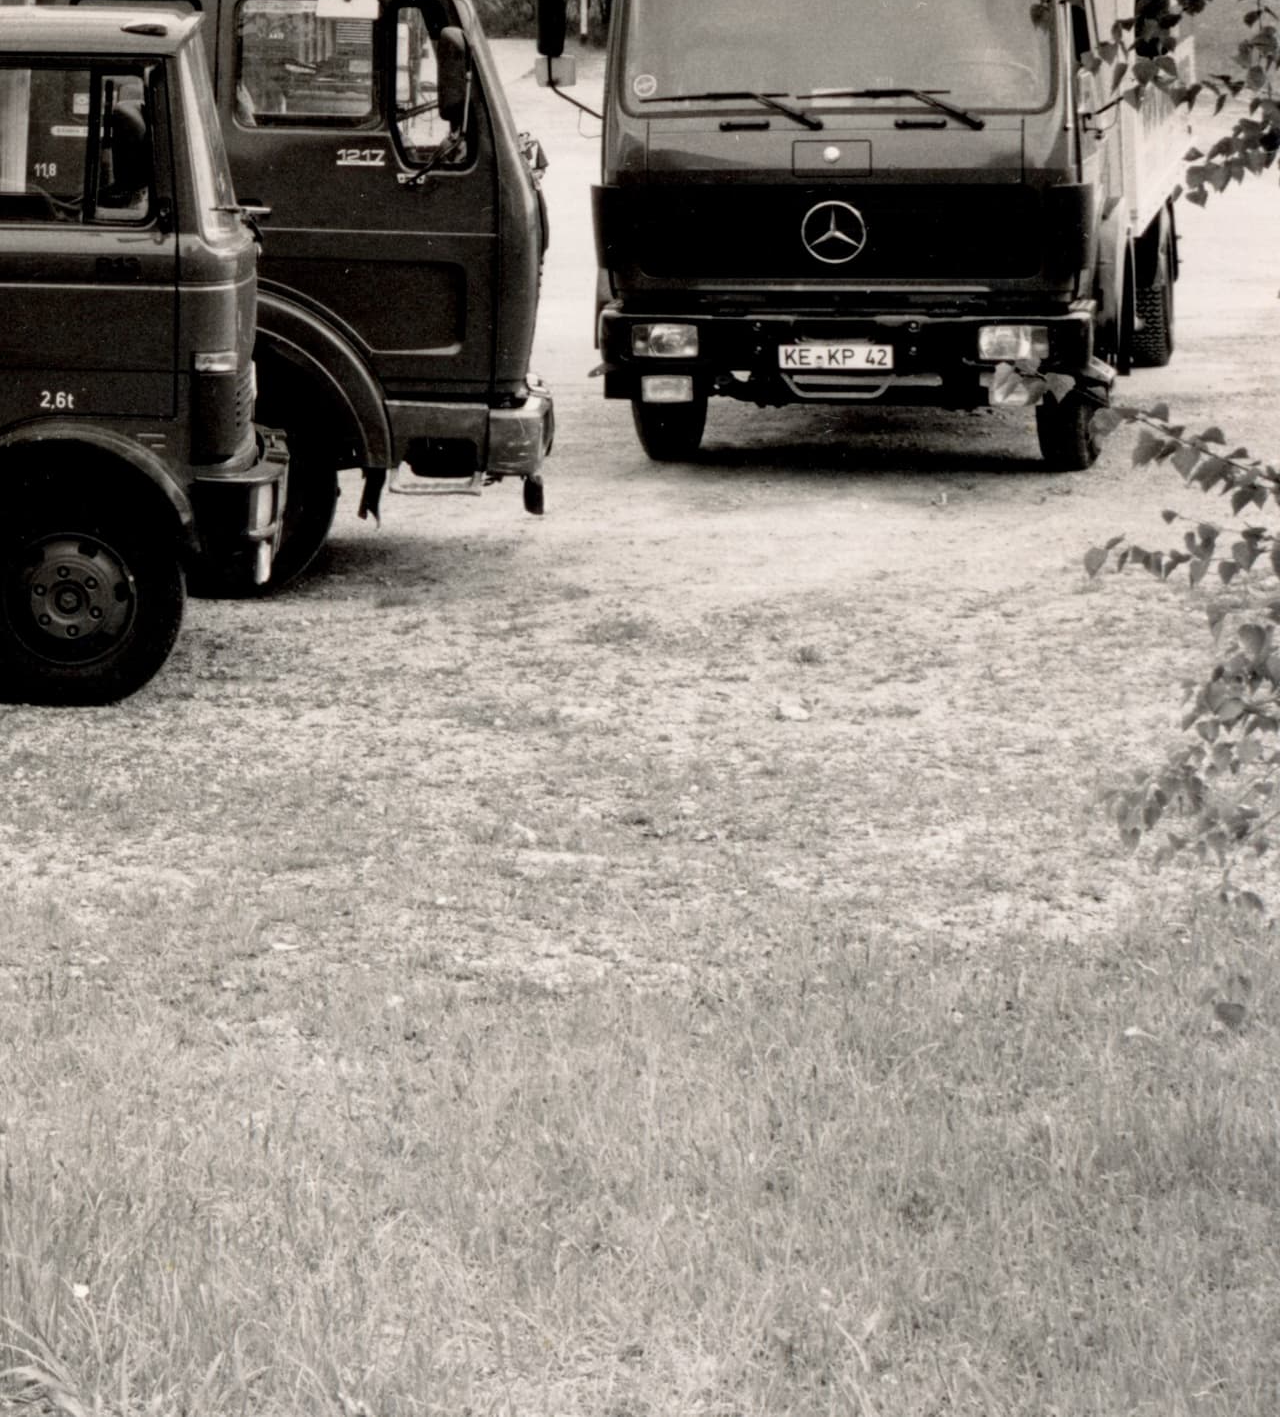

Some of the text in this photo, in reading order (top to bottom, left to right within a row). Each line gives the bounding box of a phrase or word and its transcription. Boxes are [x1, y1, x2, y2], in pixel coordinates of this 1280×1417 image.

[336, 148, 386, 165] 1217
[864, 348, 888, 366] 42
[40, 390, 75, 411] 2,6t
